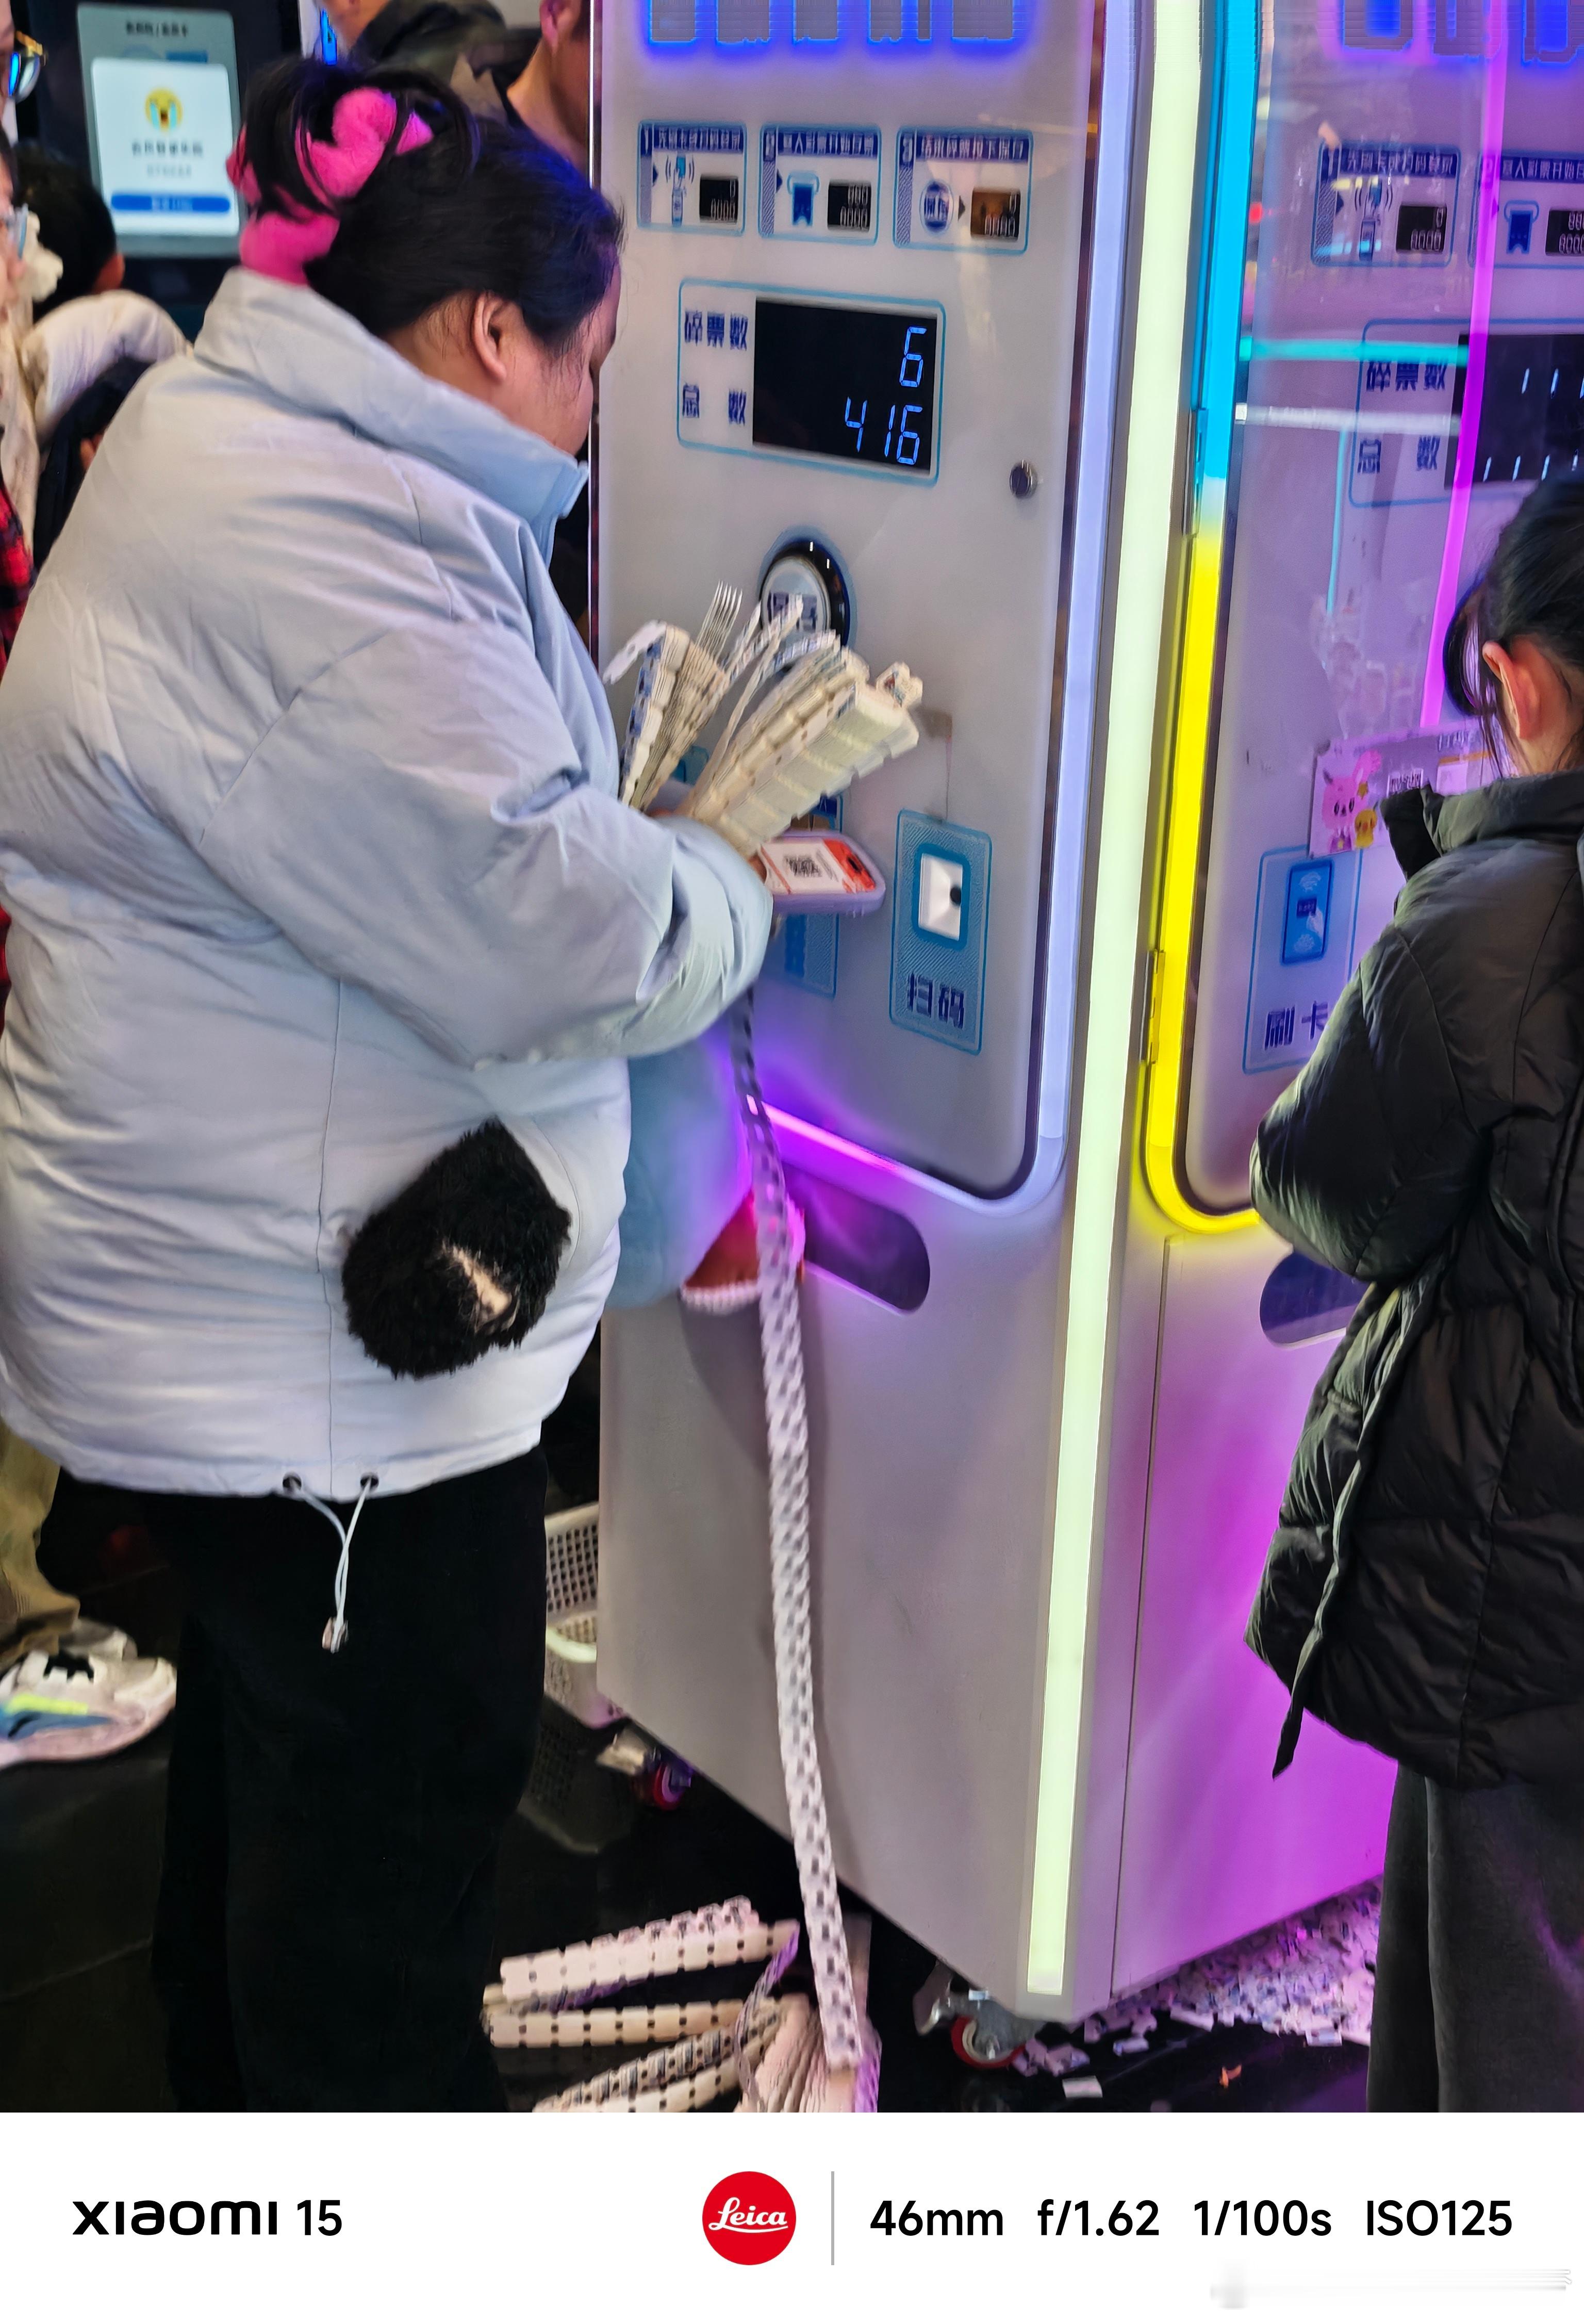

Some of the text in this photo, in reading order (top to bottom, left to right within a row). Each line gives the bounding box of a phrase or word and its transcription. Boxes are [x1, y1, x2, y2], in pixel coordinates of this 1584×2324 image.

[684, 310, 749, 351] 碎票数
[899, 326, 928, 388] 6
[844, 396, 923, 466] 416
[906, 972, 965, 1029] 扫码
[1264, 1001, 1329, 1051] 刷卡
